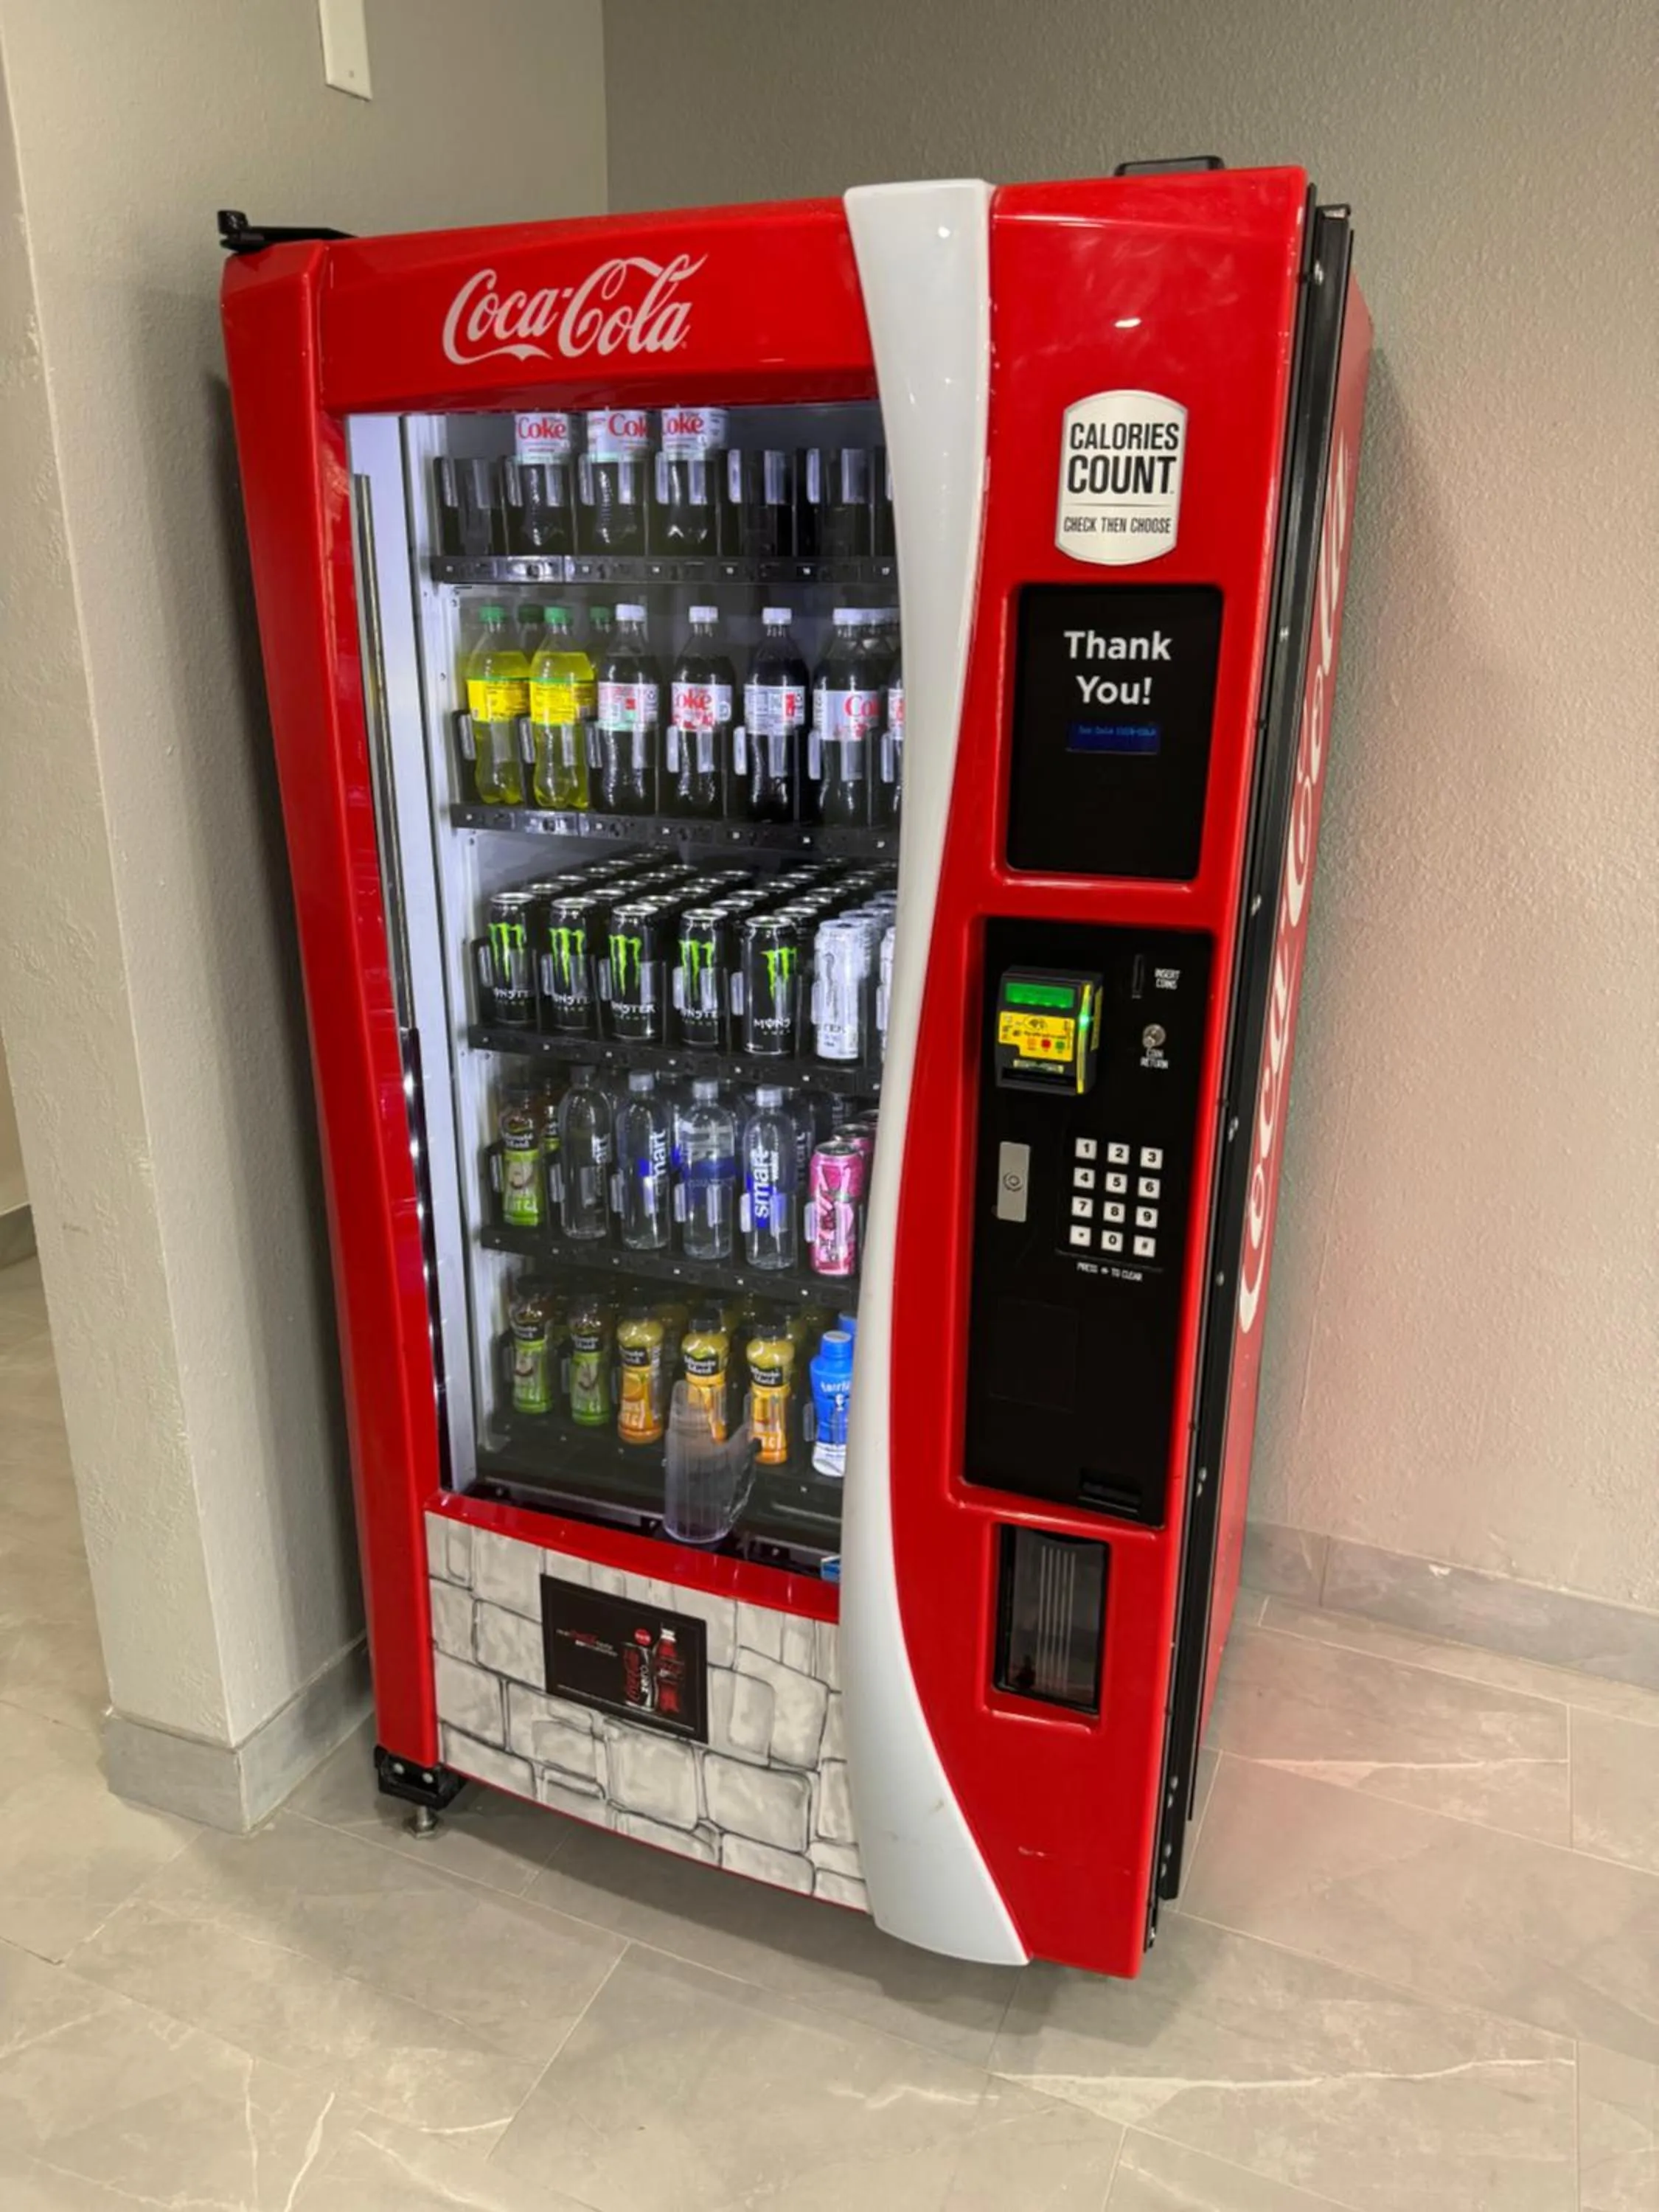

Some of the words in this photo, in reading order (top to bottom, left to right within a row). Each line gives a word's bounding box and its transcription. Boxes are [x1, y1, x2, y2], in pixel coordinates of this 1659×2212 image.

[443, 253, 708, 365] Coca-Cola
[517, 415, 567, 440] Coke
[1069, 422, 1180, 451] CALORIES
[1067, 454, 1178, 495] COUNT
[1064, 516, 1097, 532] CHECK
[1101, 517, 1127, 532] THEN
[1130, 518, 1172, 534] CHOOSE
[1063, 630, 1173, 661] Thank
[1076, 675, 1152, 705] You!
[1155, 967, 1180, 980] INSERT
[1155, 978, 1178, 990] COINS
[1140, 1057, 1169, 1069] RETURN
[1084, 1142, 1090, 1153] 1
[1116, 1147, 1124, 1158] 2
[1147, 1152, 1156, 1163] 3
[749, 1147, 771, 1220] smart
[1080, 1172, 1089, 1182] 4
[1113, 1177, 1121, 1188] 5
[1145, 1181, 1154, 1192] 6
[1079, 1201, 1087, 1211] 7
[1110, 1206, 1119, 1217] 8
[1144, 1211, 1152, 1222] 9
[1108, 1234, 1117, 1245] 0
[1077, 1262, 1099, 1273] PRESS
[1111, 1267, 1121, 1277] TO
[1121, 1269, 1143, 1281] CLEAR
